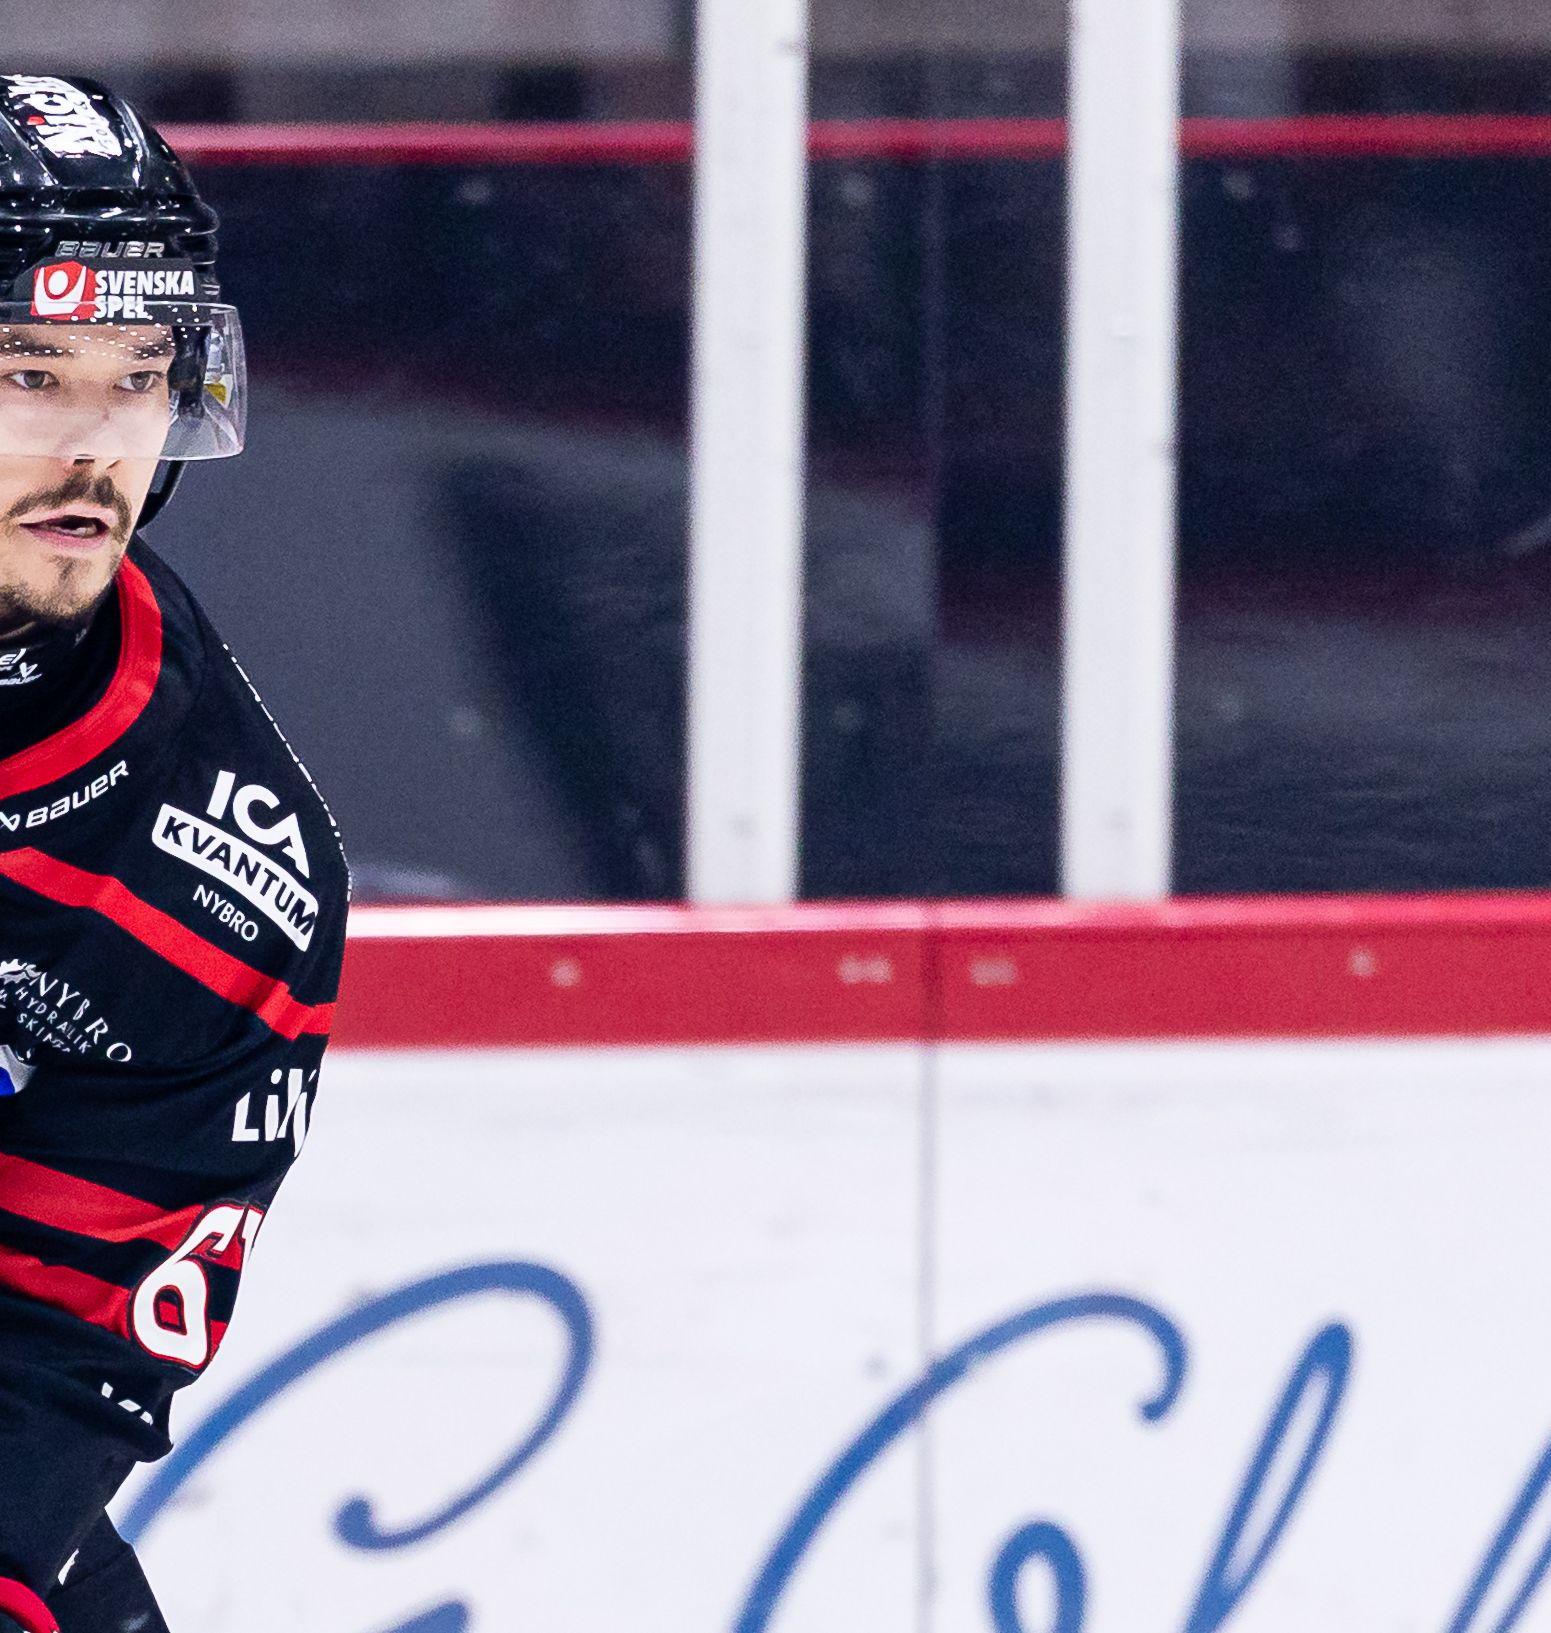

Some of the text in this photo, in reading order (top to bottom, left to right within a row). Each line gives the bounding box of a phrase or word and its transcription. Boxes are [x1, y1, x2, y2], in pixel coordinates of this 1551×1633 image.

[54, 240, 166, 258] BAUER
[93, 294, 149, 320] SPEL
[94, 270, 195, 296] SVENSKA
[25, 760, 129, 829] BAUER
[205, 769, 310, 879] ICA
[161, 815, 317, 938] KVANTUM
[193, 883, 260, 943] NYBRO
[29, 971, 132, 1063] NYBRO
